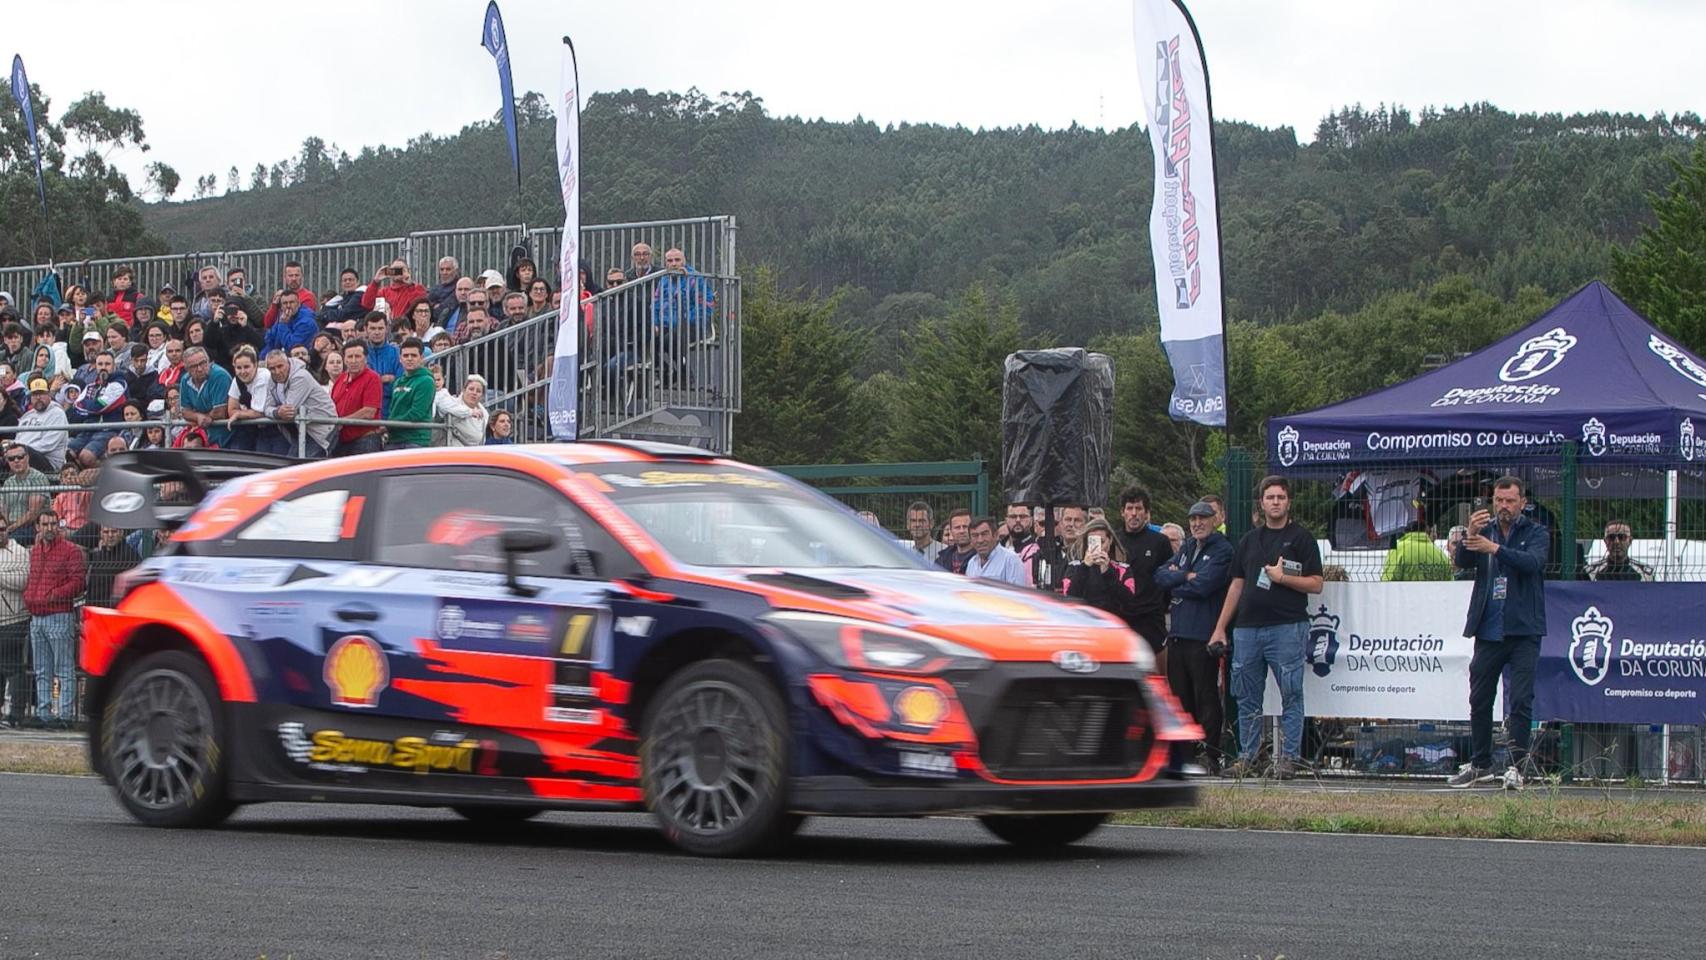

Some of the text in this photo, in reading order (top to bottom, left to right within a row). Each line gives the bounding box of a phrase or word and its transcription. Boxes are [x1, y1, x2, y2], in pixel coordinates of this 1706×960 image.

[1443, 384, 1561, 399] Deputación
[1430, 397, 1460, 407] DA
[1302, 439, 1351, 453] Deputación
[1366, 431, 1471, 452] Compromiso
[1476, 432, 1498, 446] co
[1608, 433, 1661, 446] Deputación
[561, 614, 594, 654] 1
[1348, 633, 1445, 656] Deputación
[1620, 638, 1706, 661] Deputació
[1346, 651, 1444, 673] DA CORUÑA
[1620, 659, 1644, 677] DA
[1330, 683, 1416, 694] Compromiso co deporte
[1604, 687, 1697, 700] Compromiso co deporte
[391, 736, 480, 775] Sport
